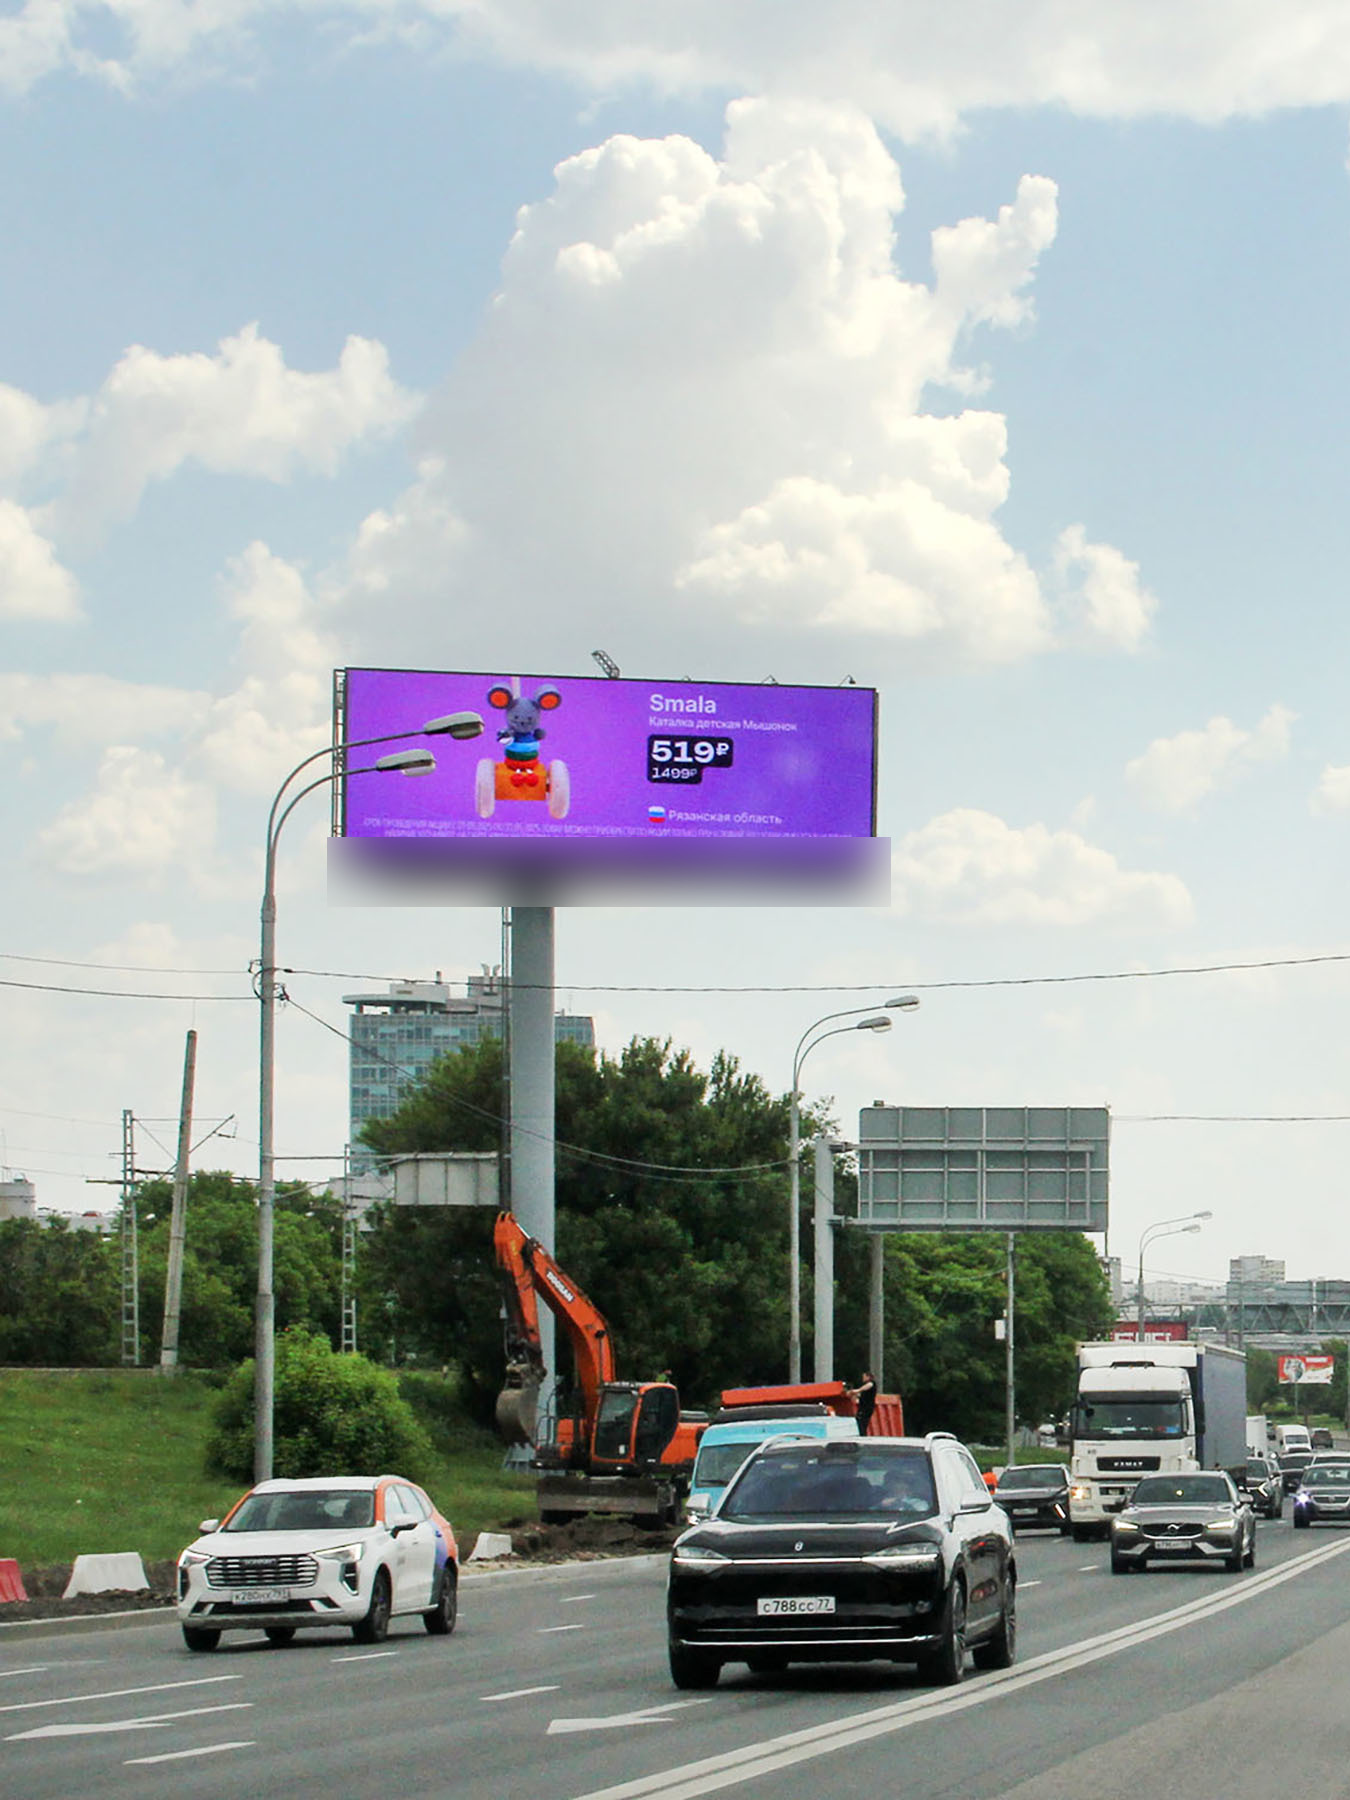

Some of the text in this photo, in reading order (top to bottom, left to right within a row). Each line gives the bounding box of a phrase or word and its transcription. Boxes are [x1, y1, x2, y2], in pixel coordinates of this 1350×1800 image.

[650, 694, 717, 714] Smala
[649, 717, 798, 732] Каталка детская Мышонок
[668, 809, 783, 825] Рязанская область
